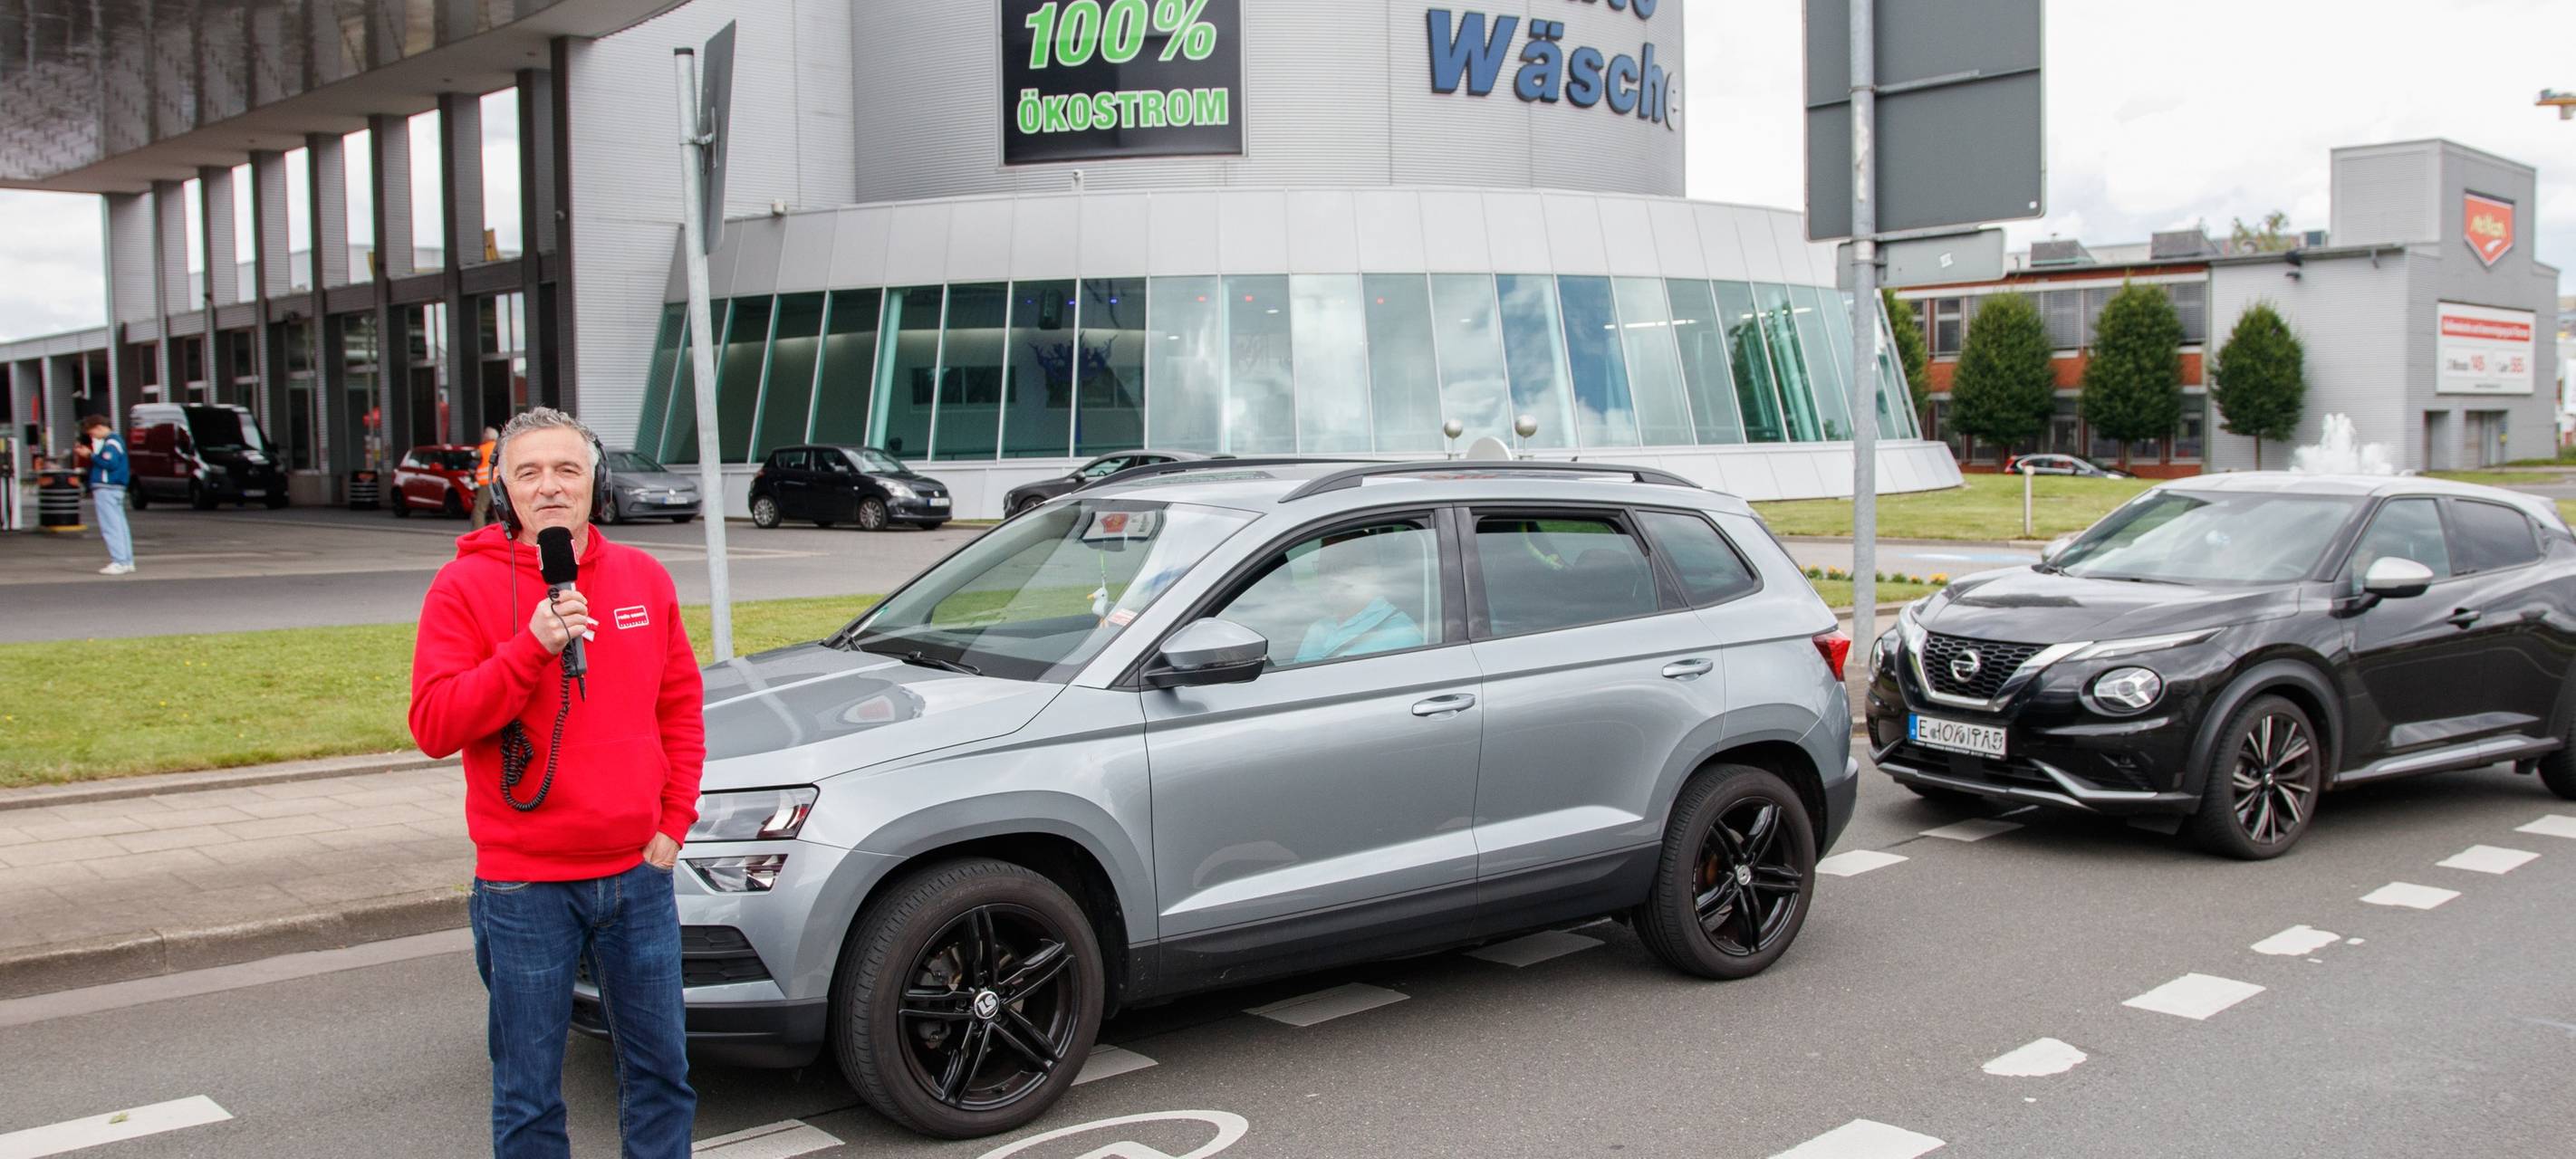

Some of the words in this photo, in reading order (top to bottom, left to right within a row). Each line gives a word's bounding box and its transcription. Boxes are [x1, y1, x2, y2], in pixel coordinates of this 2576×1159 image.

[1025, 0, 1216, 69] 100%
[1017, 88, 1228, 134] ÖKOSTROM
[977, 994, 997, 1015] LS
